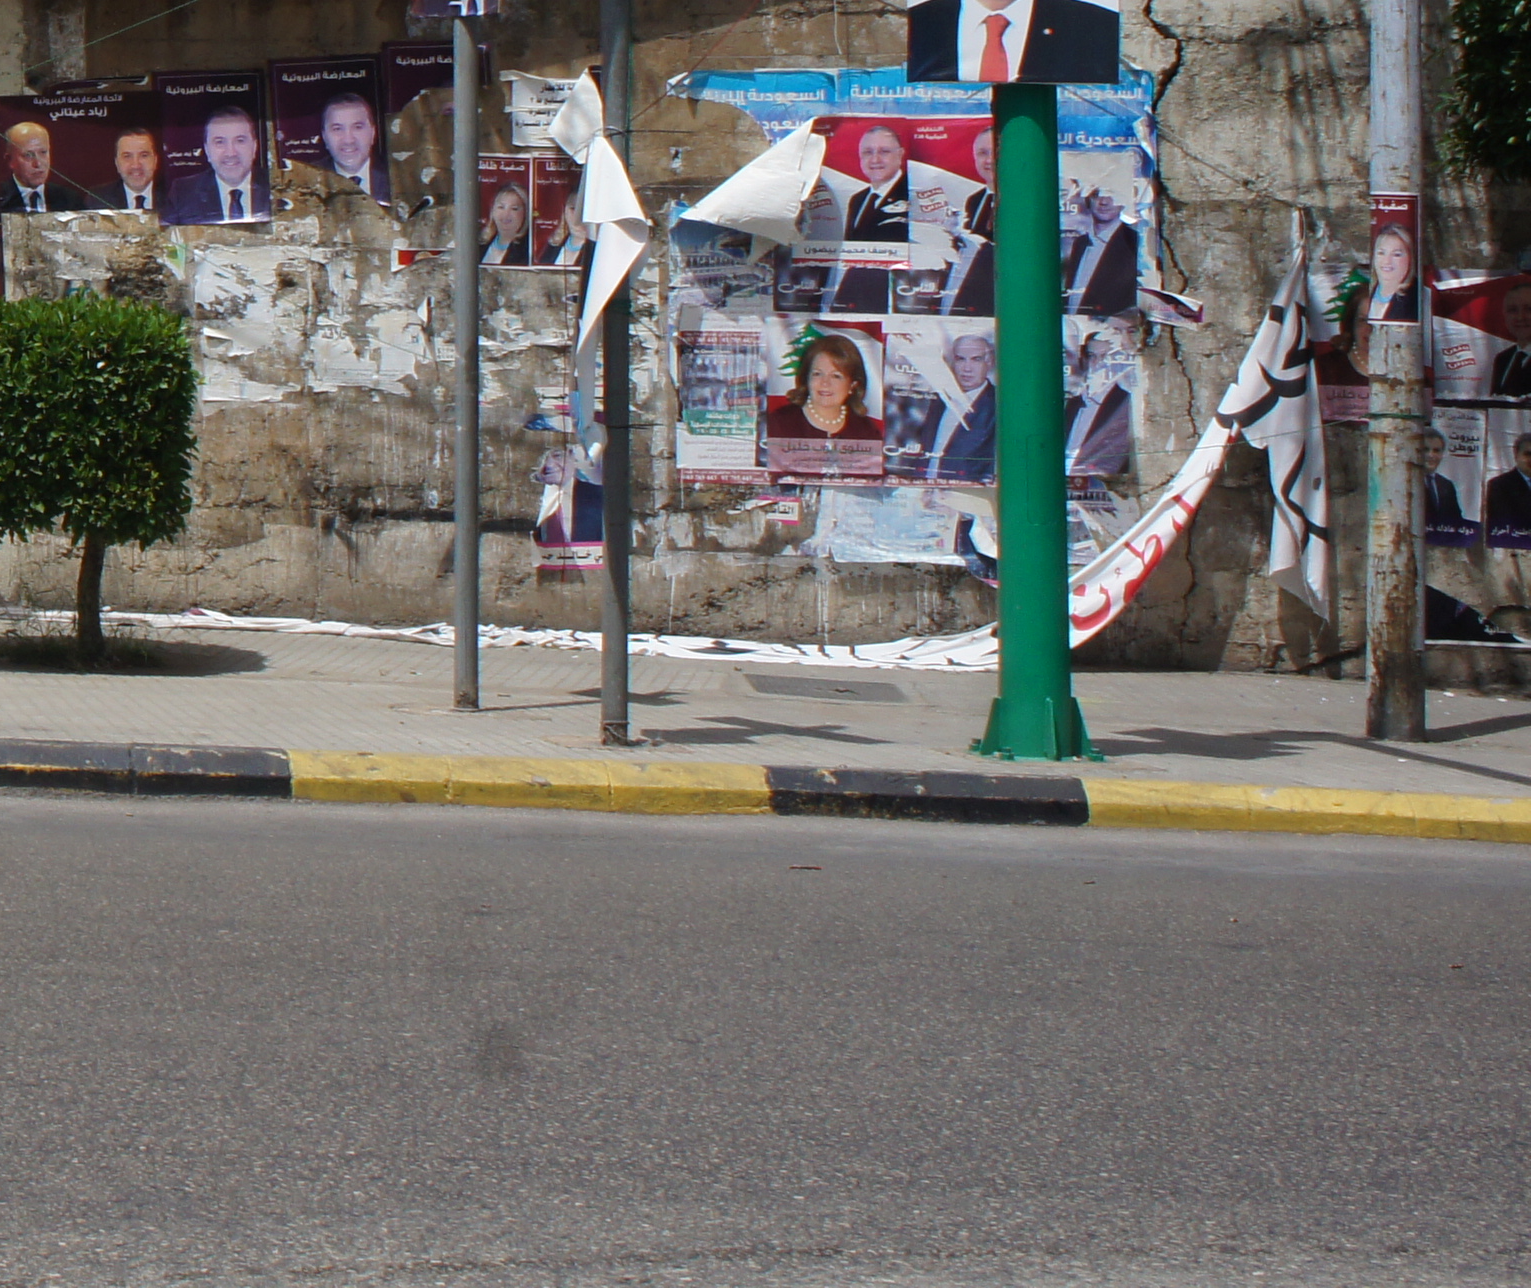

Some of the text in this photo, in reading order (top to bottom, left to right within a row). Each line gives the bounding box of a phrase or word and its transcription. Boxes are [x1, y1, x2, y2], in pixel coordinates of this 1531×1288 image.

[395, 54, 436, 66] البيروتية
[281, 69, 367, 83] المعارضة البيروتية
[165, 82, 250, 96] المعارضة البيروتية
[850, 84, 913, 100] اللبنانية
[33, 96, 66, 106] البيروتية
[66, 95, 101, 104] المعارضة
[747, 88, 825, 105] السعودية
[49, 106, 108, 121] زياد عيتاني
[499, 160, 526, 173] صفية
[1378, 200, 1409, 213] صفية
[803, 246, 898, 256] يوسف محمد بيضون
[896, 282, 936, 296] الناس
[1448, 432, 1480, 443] بيروت
[882, 442, 921, 457] الناس
[1448, 443, 1479, 454] الوطن
